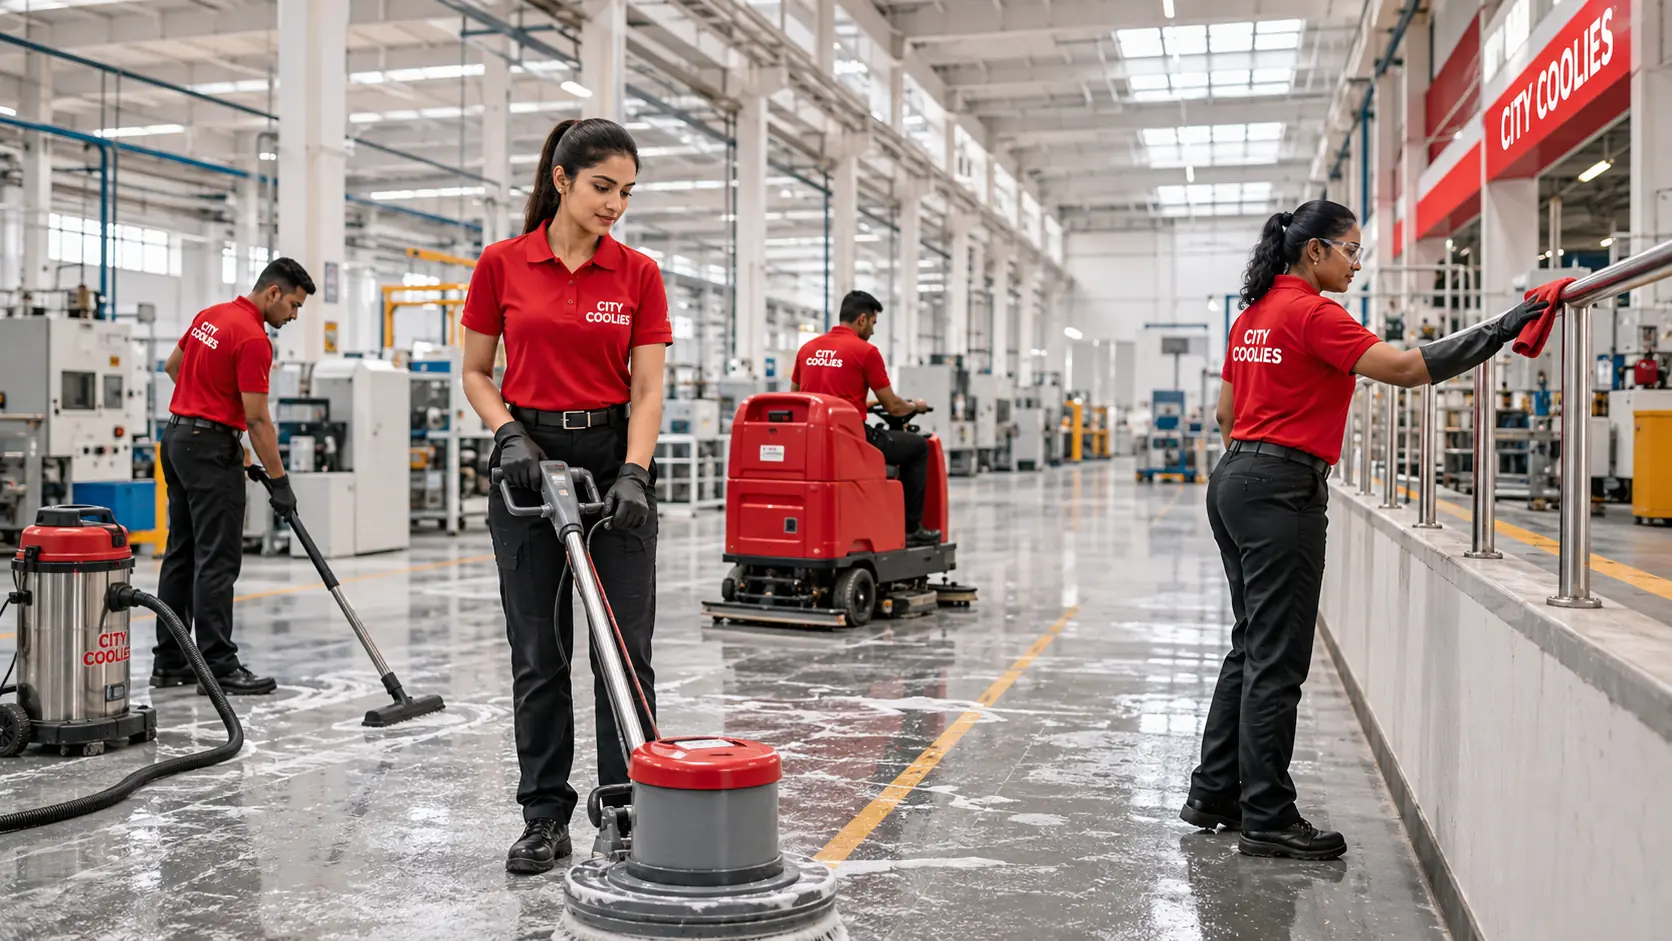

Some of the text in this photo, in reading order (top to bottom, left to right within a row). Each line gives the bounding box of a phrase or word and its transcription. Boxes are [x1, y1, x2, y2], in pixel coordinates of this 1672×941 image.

[1501, 7, 1614, 151] CITY COOLIES
[597, 301, 624, 313] CITY
[585, 311, 630, 326] COOLIES
[201, 321, 219, 336] CITY
[1243, 328, 1271, 345] CITY
[191, 327, 219, 350] COOLIES
[815, 349, 837, 358] CITY
[1232, 346, 1282, 364] COOLIES
[806, 357, 843, 368] COOLIES
[98, 631, 127, 649] CITY
